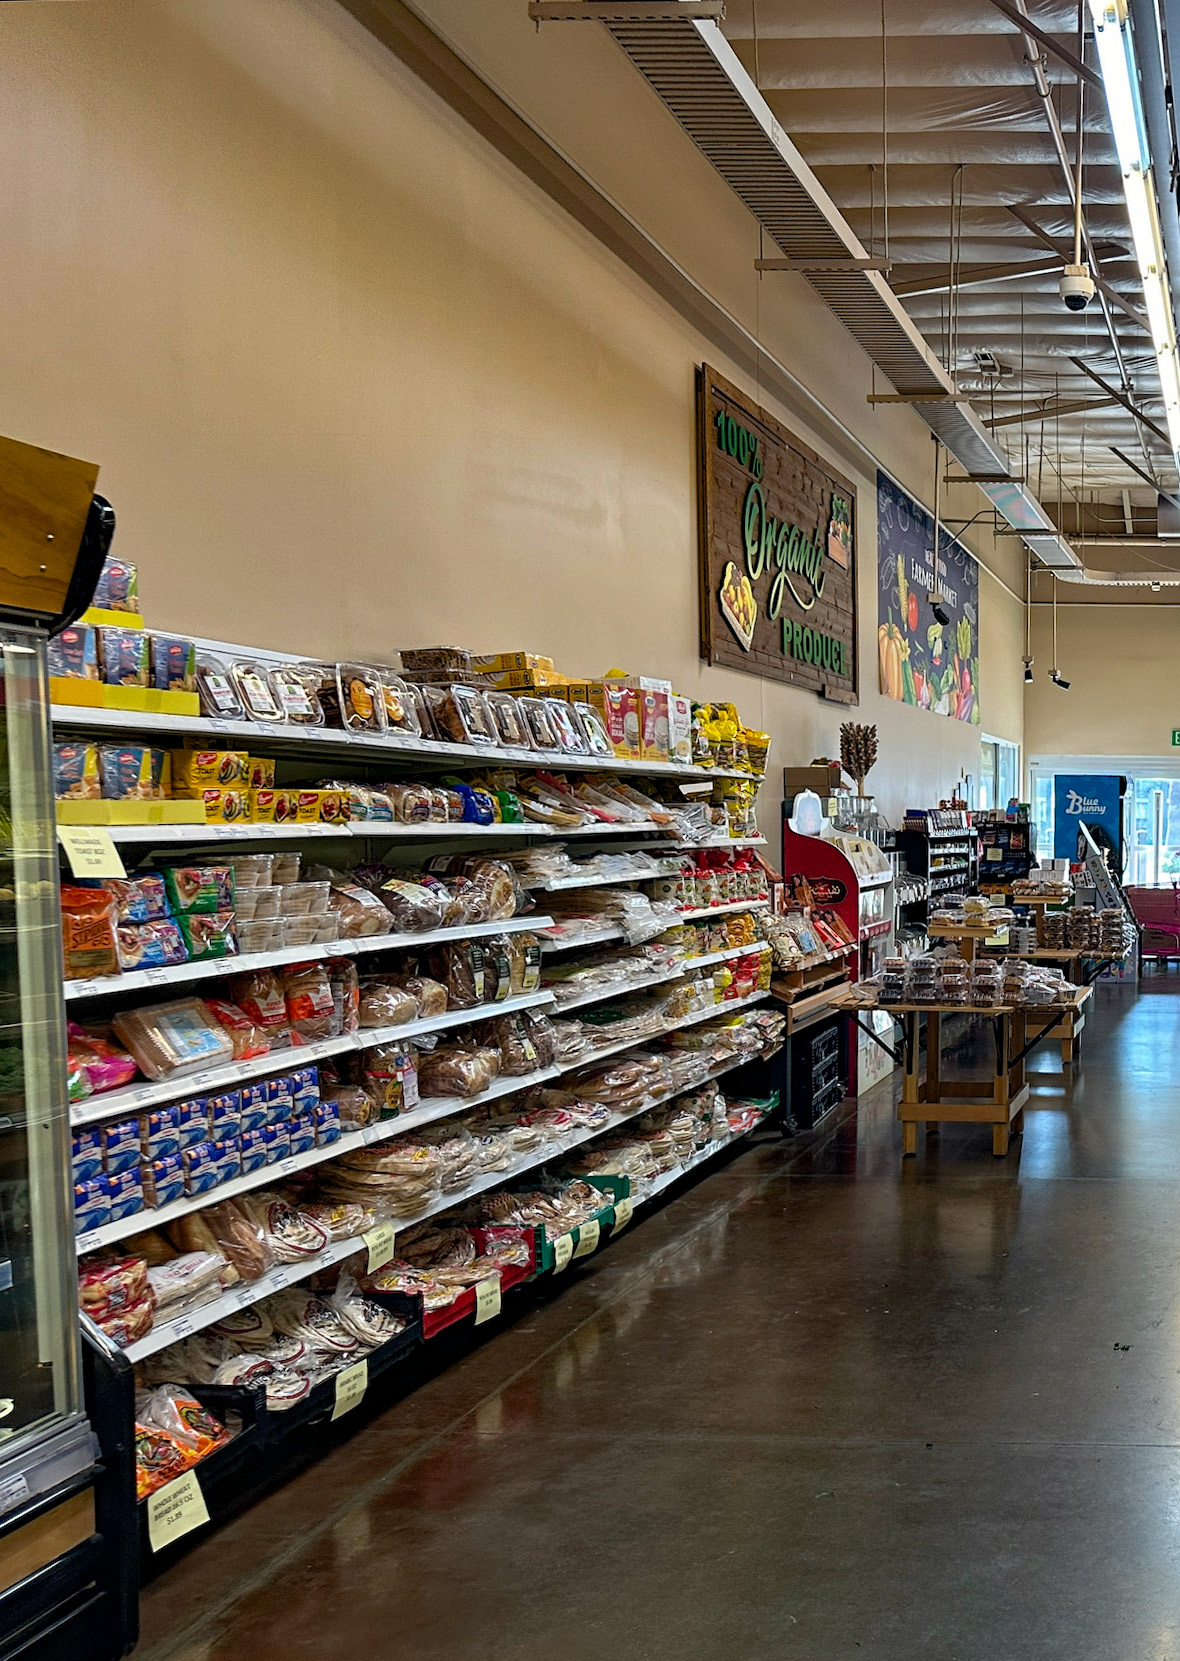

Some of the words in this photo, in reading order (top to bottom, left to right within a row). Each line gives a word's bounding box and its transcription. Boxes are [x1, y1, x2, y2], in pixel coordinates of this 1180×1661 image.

[717, 410, 763, 479] 100%
[744, 482, 827, 620] Organic
[782, 616, 847, 675] PRODUCE
[197, 767, 215, 775] TOAST
[153, 1495, 173, 1511] WHOLE
[173, 1483, 191, 1499] WHEAT
[154, 1506, 172, 1521] BREAD
